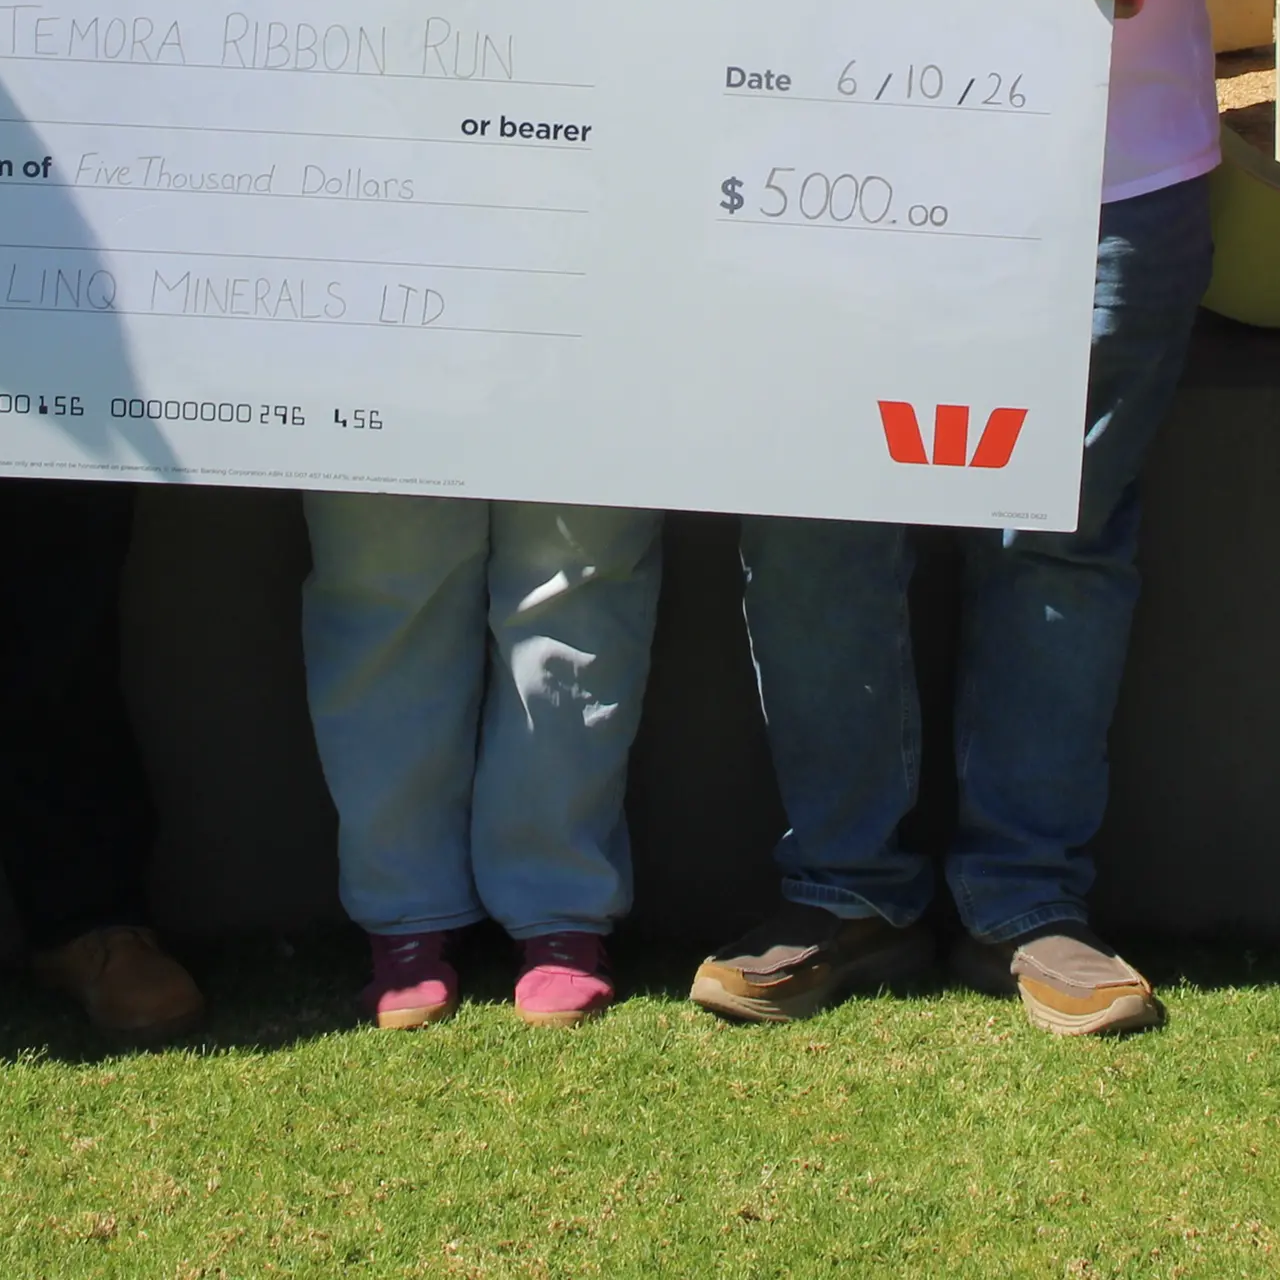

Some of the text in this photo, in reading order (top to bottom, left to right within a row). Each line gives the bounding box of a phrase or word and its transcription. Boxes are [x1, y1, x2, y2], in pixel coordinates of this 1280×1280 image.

[220, 12, 387, 76] RIBBON
[421, 16, 513, 80] RUN
[725, 66, 792, 91] Date
[461, 116, 593, 141] or bearer
[22, 156, 53, 178] of
[74, 152, 415, 200] Five Thousand Dollars
[6, 263, 117, 310] LINQ
[150, 270, 347, 320] MINERALS
[379, 283, 445, 326] LTD
